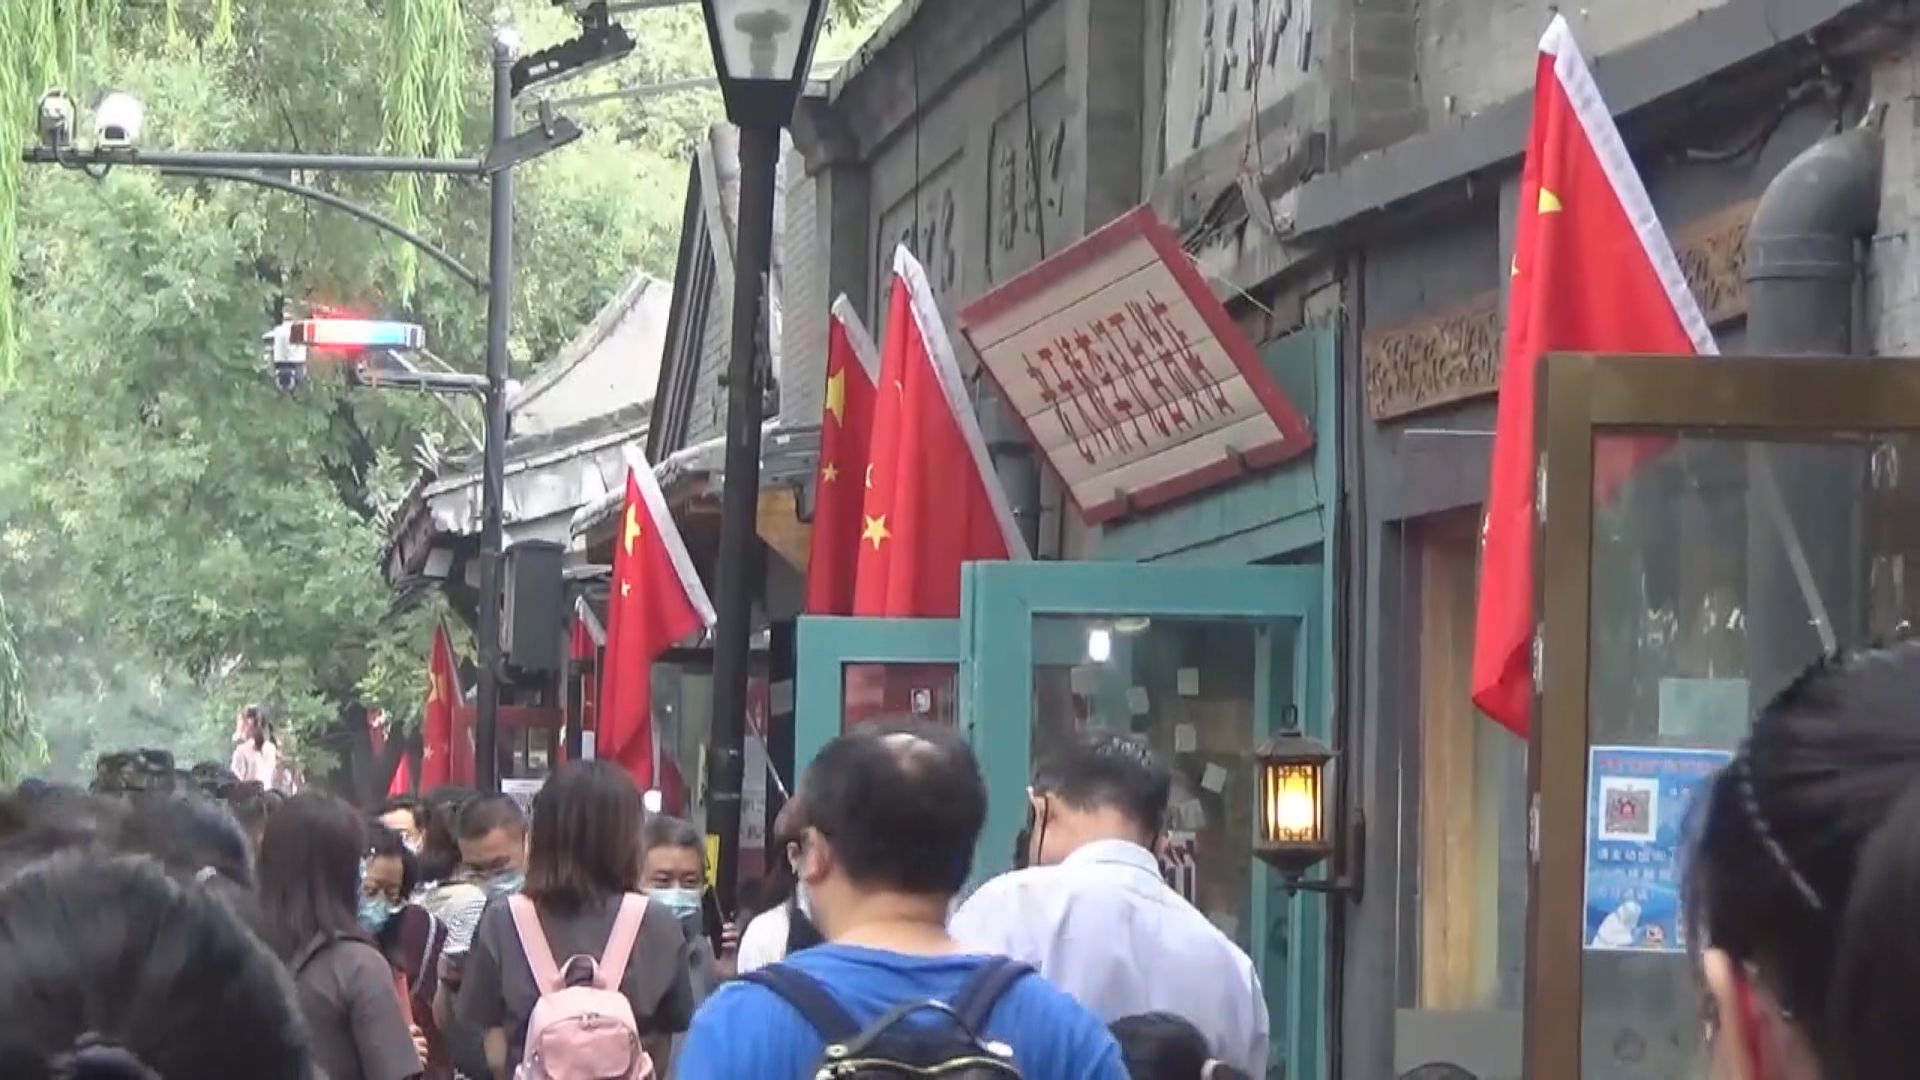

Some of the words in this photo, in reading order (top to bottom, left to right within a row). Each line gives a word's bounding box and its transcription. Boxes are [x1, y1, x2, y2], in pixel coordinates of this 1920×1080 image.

[1022, 290, 1235, 465] 老天桥李记百货店
